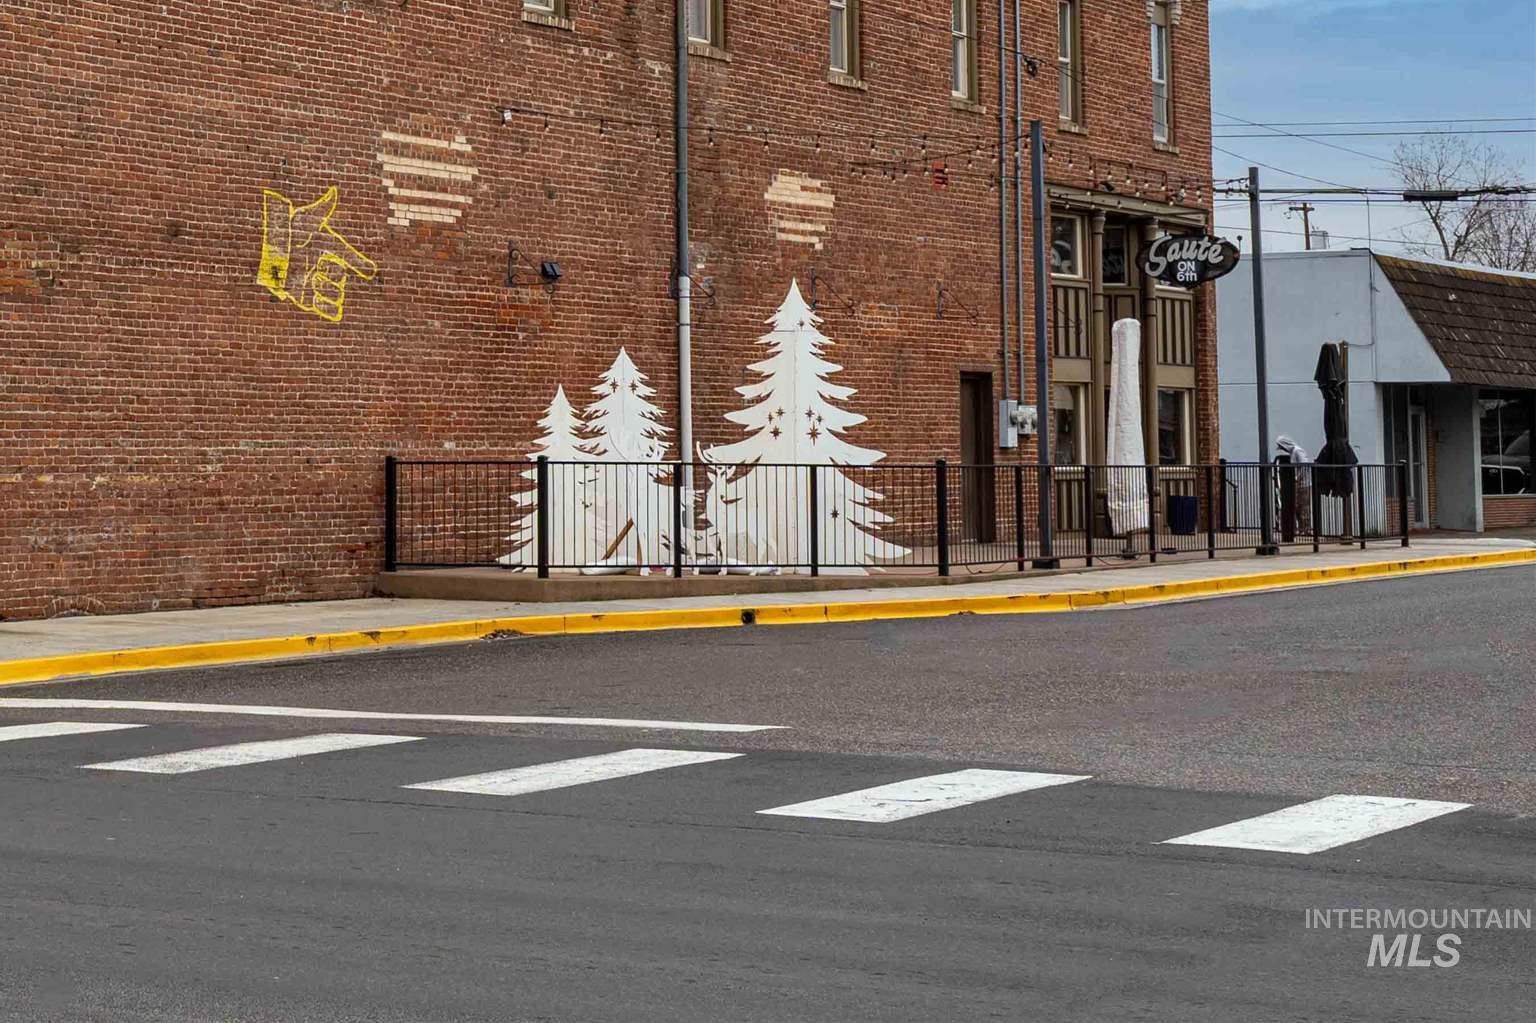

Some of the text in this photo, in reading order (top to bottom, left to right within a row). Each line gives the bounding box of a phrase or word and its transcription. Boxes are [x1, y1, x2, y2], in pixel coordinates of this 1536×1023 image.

[1145, 235, 1227, 277] Sauté
[1177, 261, 1196, 272] ON
[1176, 270, 1198, 282] 6th
